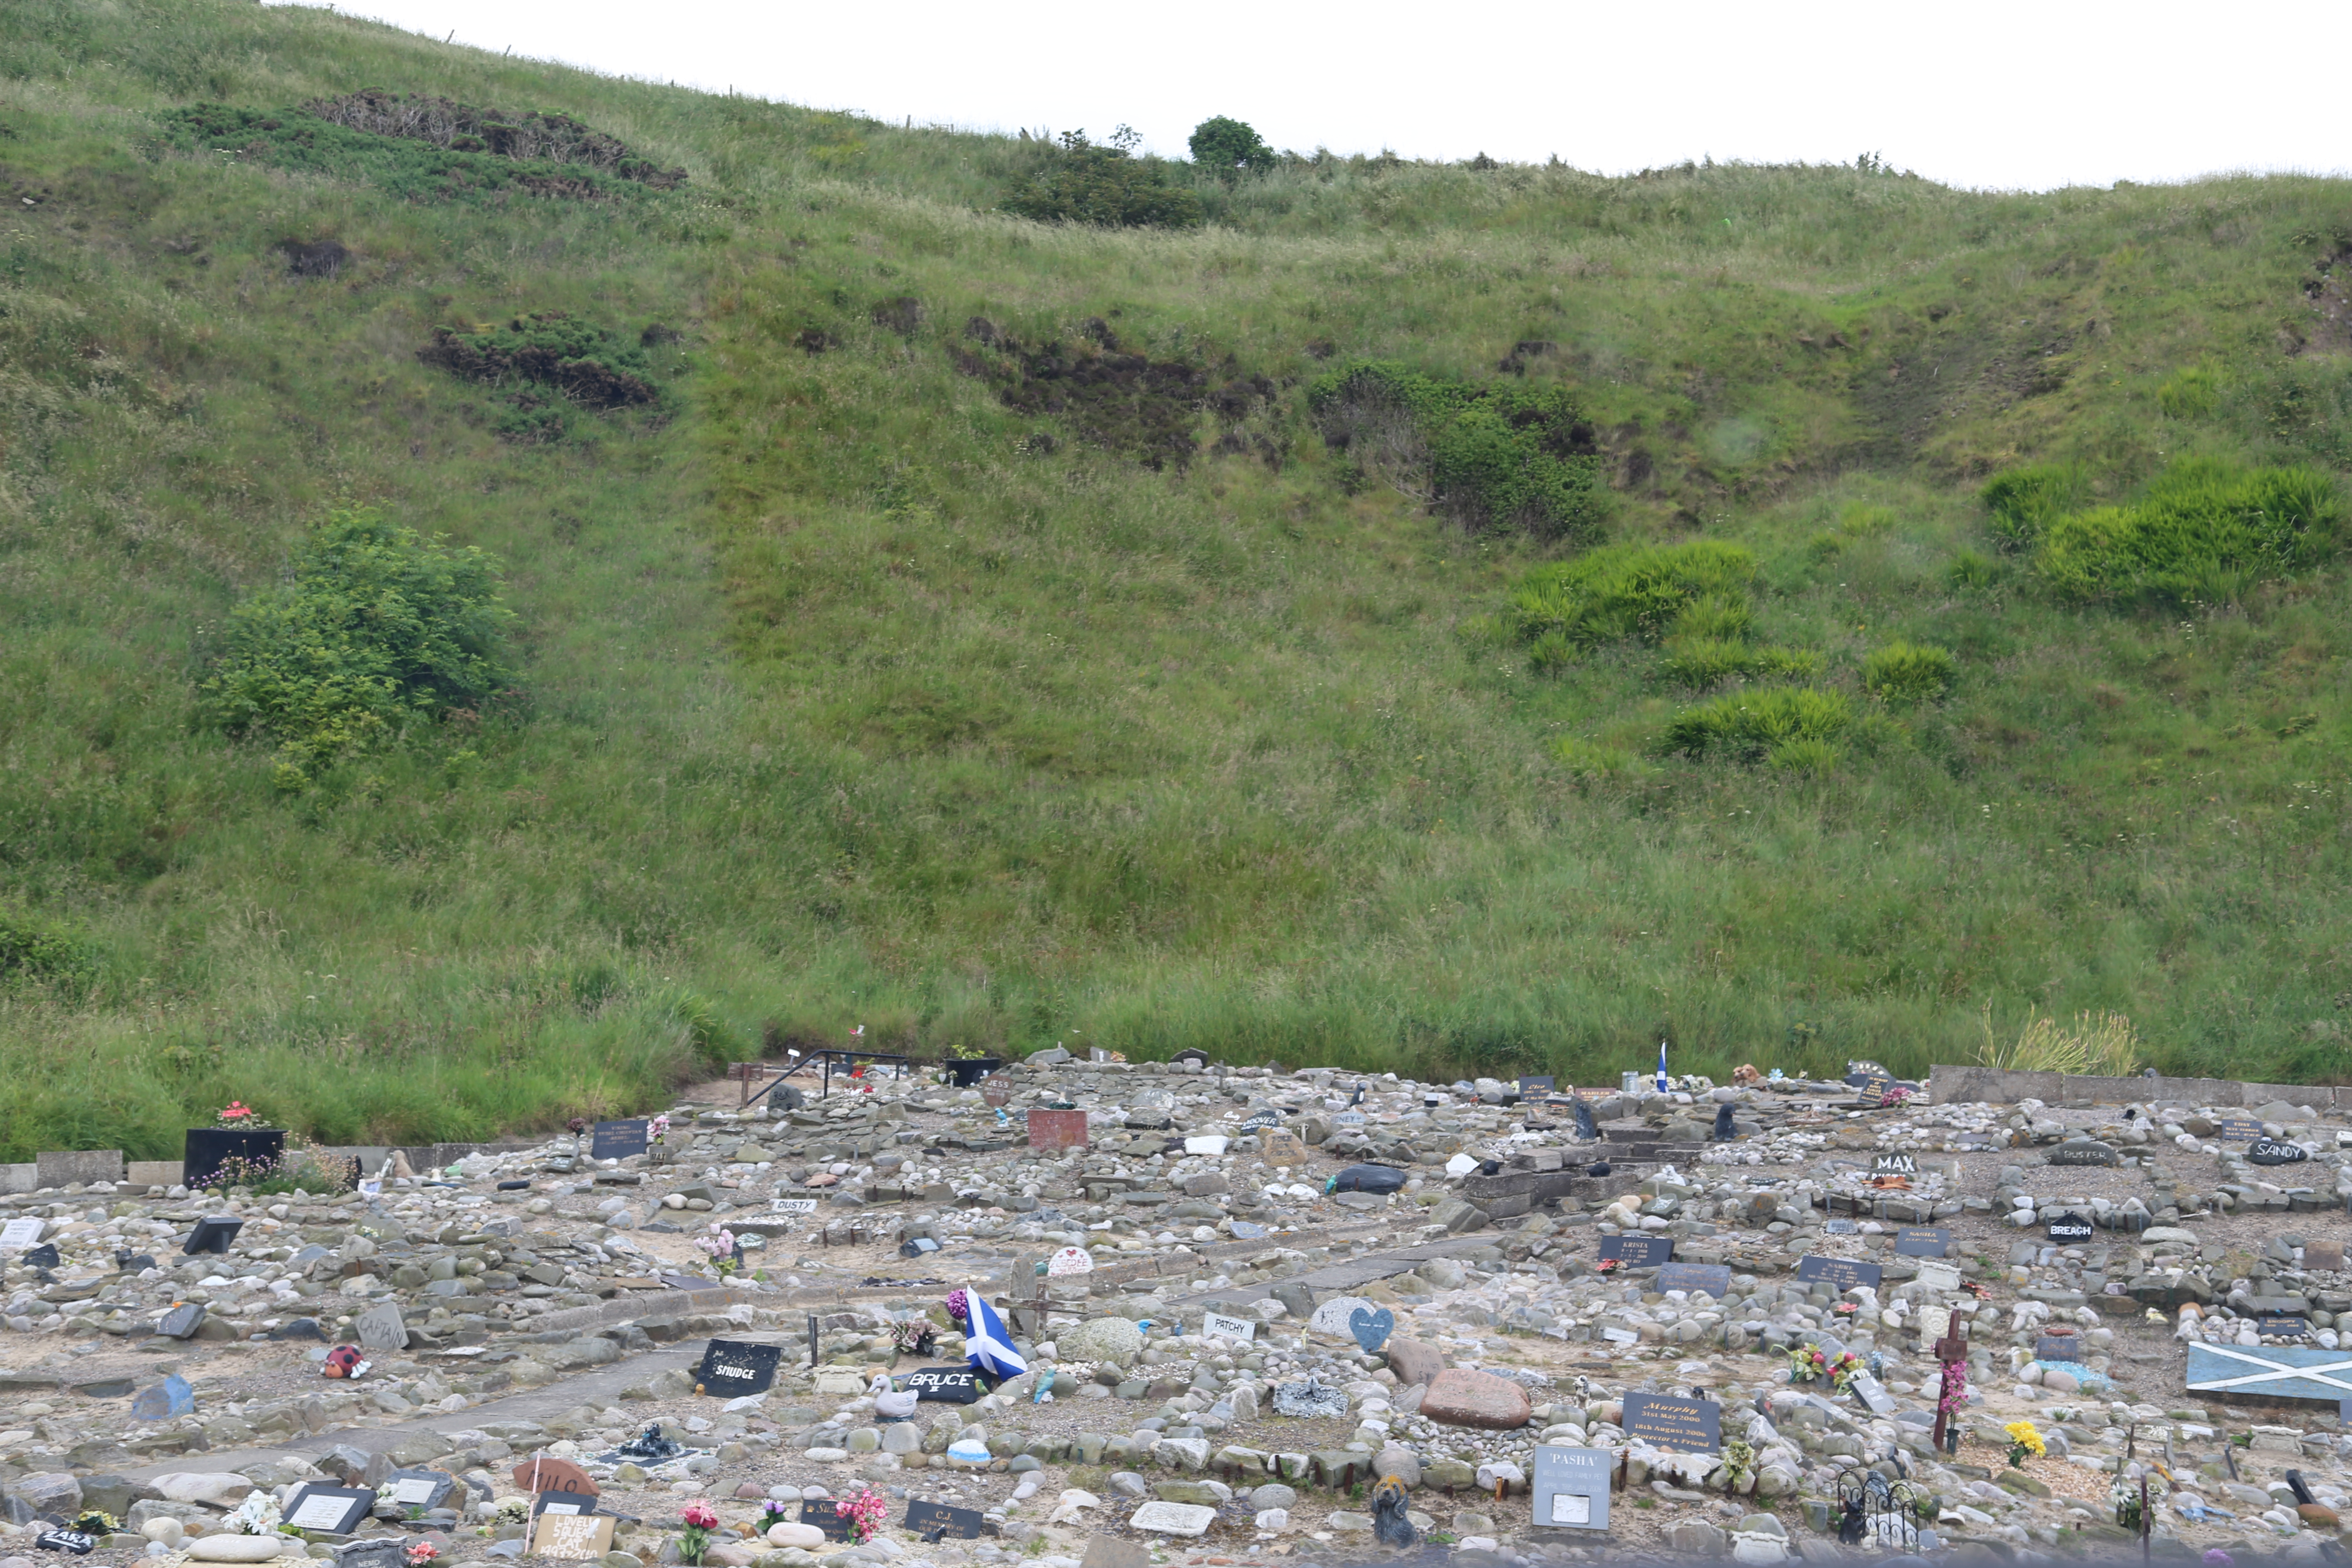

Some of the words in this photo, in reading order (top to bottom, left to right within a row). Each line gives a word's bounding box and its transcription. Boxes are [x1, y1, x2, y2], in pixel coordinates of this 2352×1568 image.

[987, 1080, 1009, 1088] JESS
[1243, 1117, 1277, 1127] HOOVER
[1331, 1115, 1356, 1123] HONEY
[2064, 1150, 2107, 1160] BUSTER
[2256, 1143, 2301, 1158] SANDY
[1877, 1155, 1915, 1172] MAX
[778, 1201, 812, 1210] DUSTY
[2050, 1225, 2091, 1236] BREAGH
[1828, 1263, 1855, 1271] SABRE
[1215, 1318, 1245, 1334] PATCHY
[360, 1317, 404, 1348] CAPTAIN
[716, 1365, 756, 1380] SMUDGE
[909, 1373, 974, 1386] BRUCE
[1643, 1402, 1699, 1415] Murphy
[1660, 1412, 1677, 1421] May
[1654, 1425, 1683, 1434] August
[1685, 1429, 1706, 1437] 2006
[1632, 1432, 1670, 1442] Protector
[1681, 1438, 1710, 1448] Friend
[1550, 1453, 1598, 1467] 'PASHA'
[526, 1469, 578, 1493] MILO
[1575, 1472, 1592, 1480] FAMILY
[1543, 1482, 1558, 1490] APRIL
[816, 1503, 838, 1517] Suz
[935, 1510, 953, 1521] C.J.
[929, 1520, 955, 1530] MEMRY
[42, 1530, 92, 1547] ZARA
[557, 1537, 583, 1550] CAT
[358, 1559, 380, 1568] NEMO
